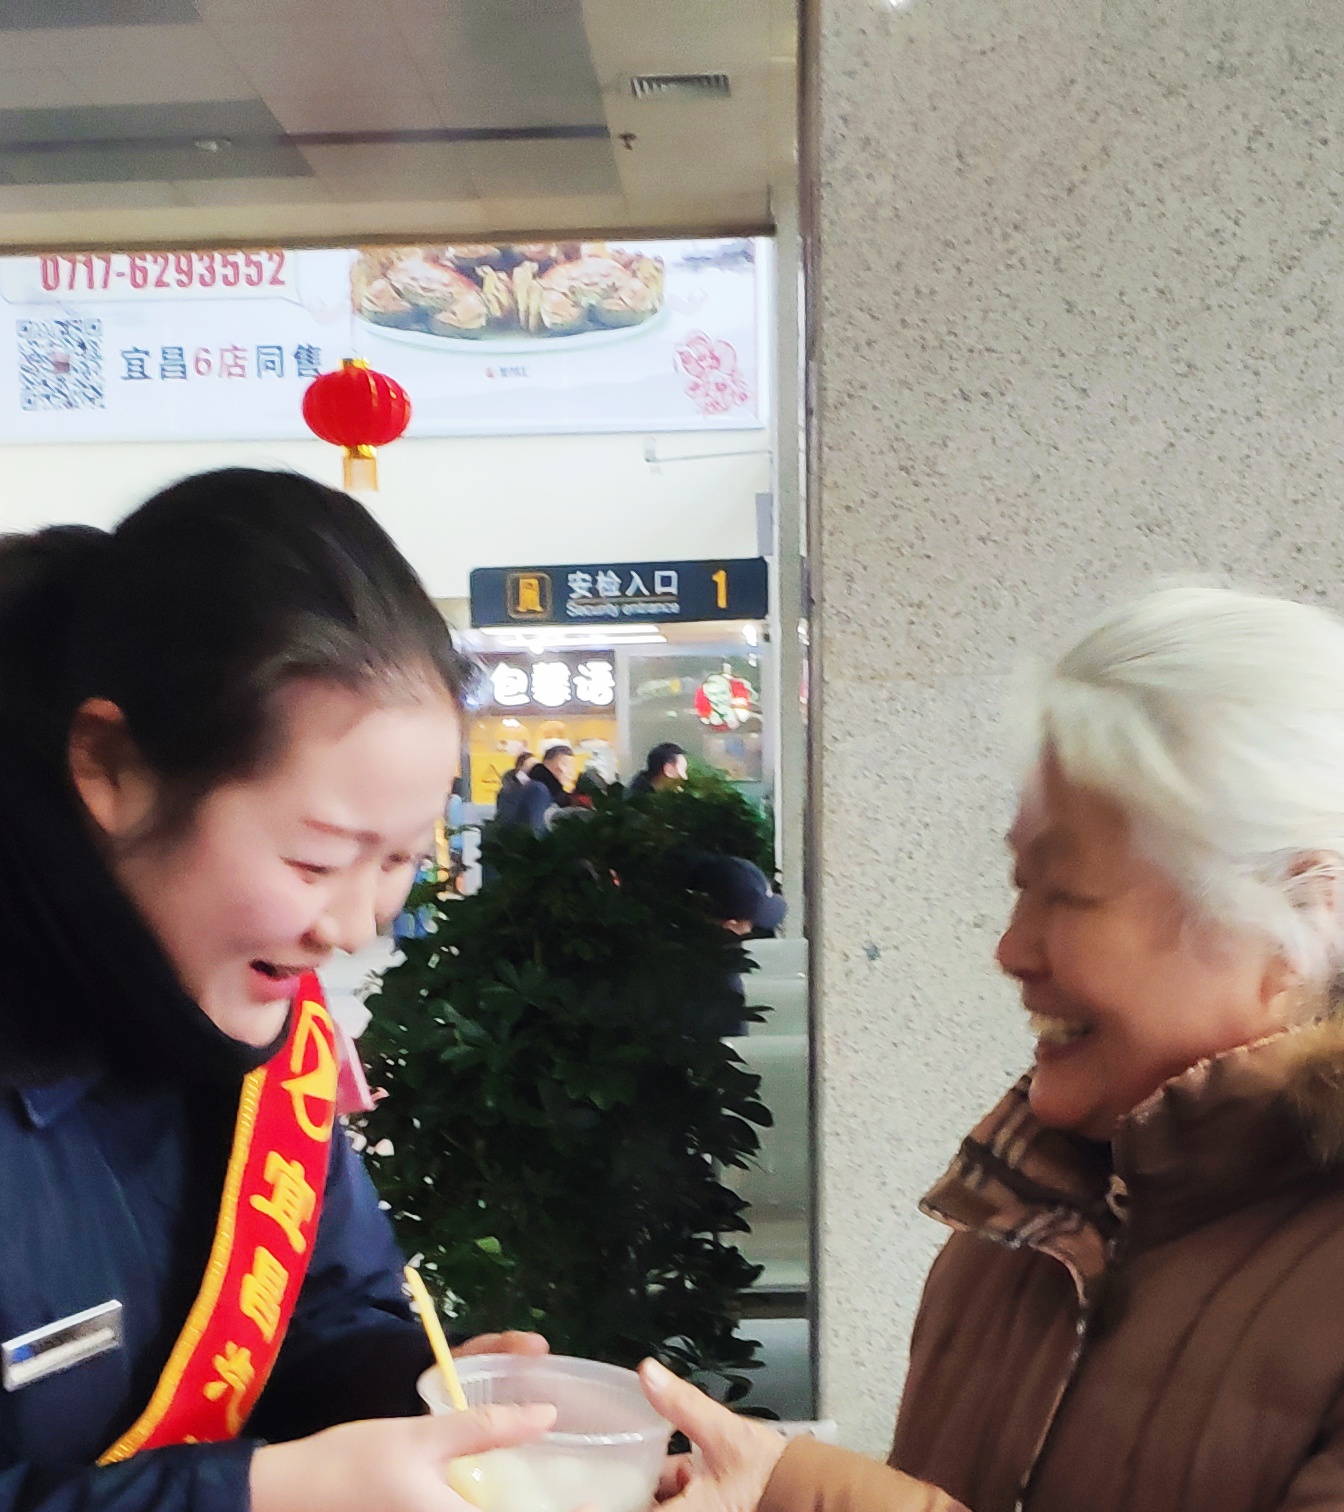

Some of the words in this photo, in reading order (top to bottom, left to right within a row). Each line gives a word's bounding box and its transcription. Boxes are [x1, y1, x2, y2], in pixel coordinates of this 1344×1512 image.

[40, 249, 286, 291] 0717-6293552
[120, 343, 323, 381] 宜昌6店同售
[567, 570, 679, 599] 安检入口
[711, 569, 729, 609] 1
